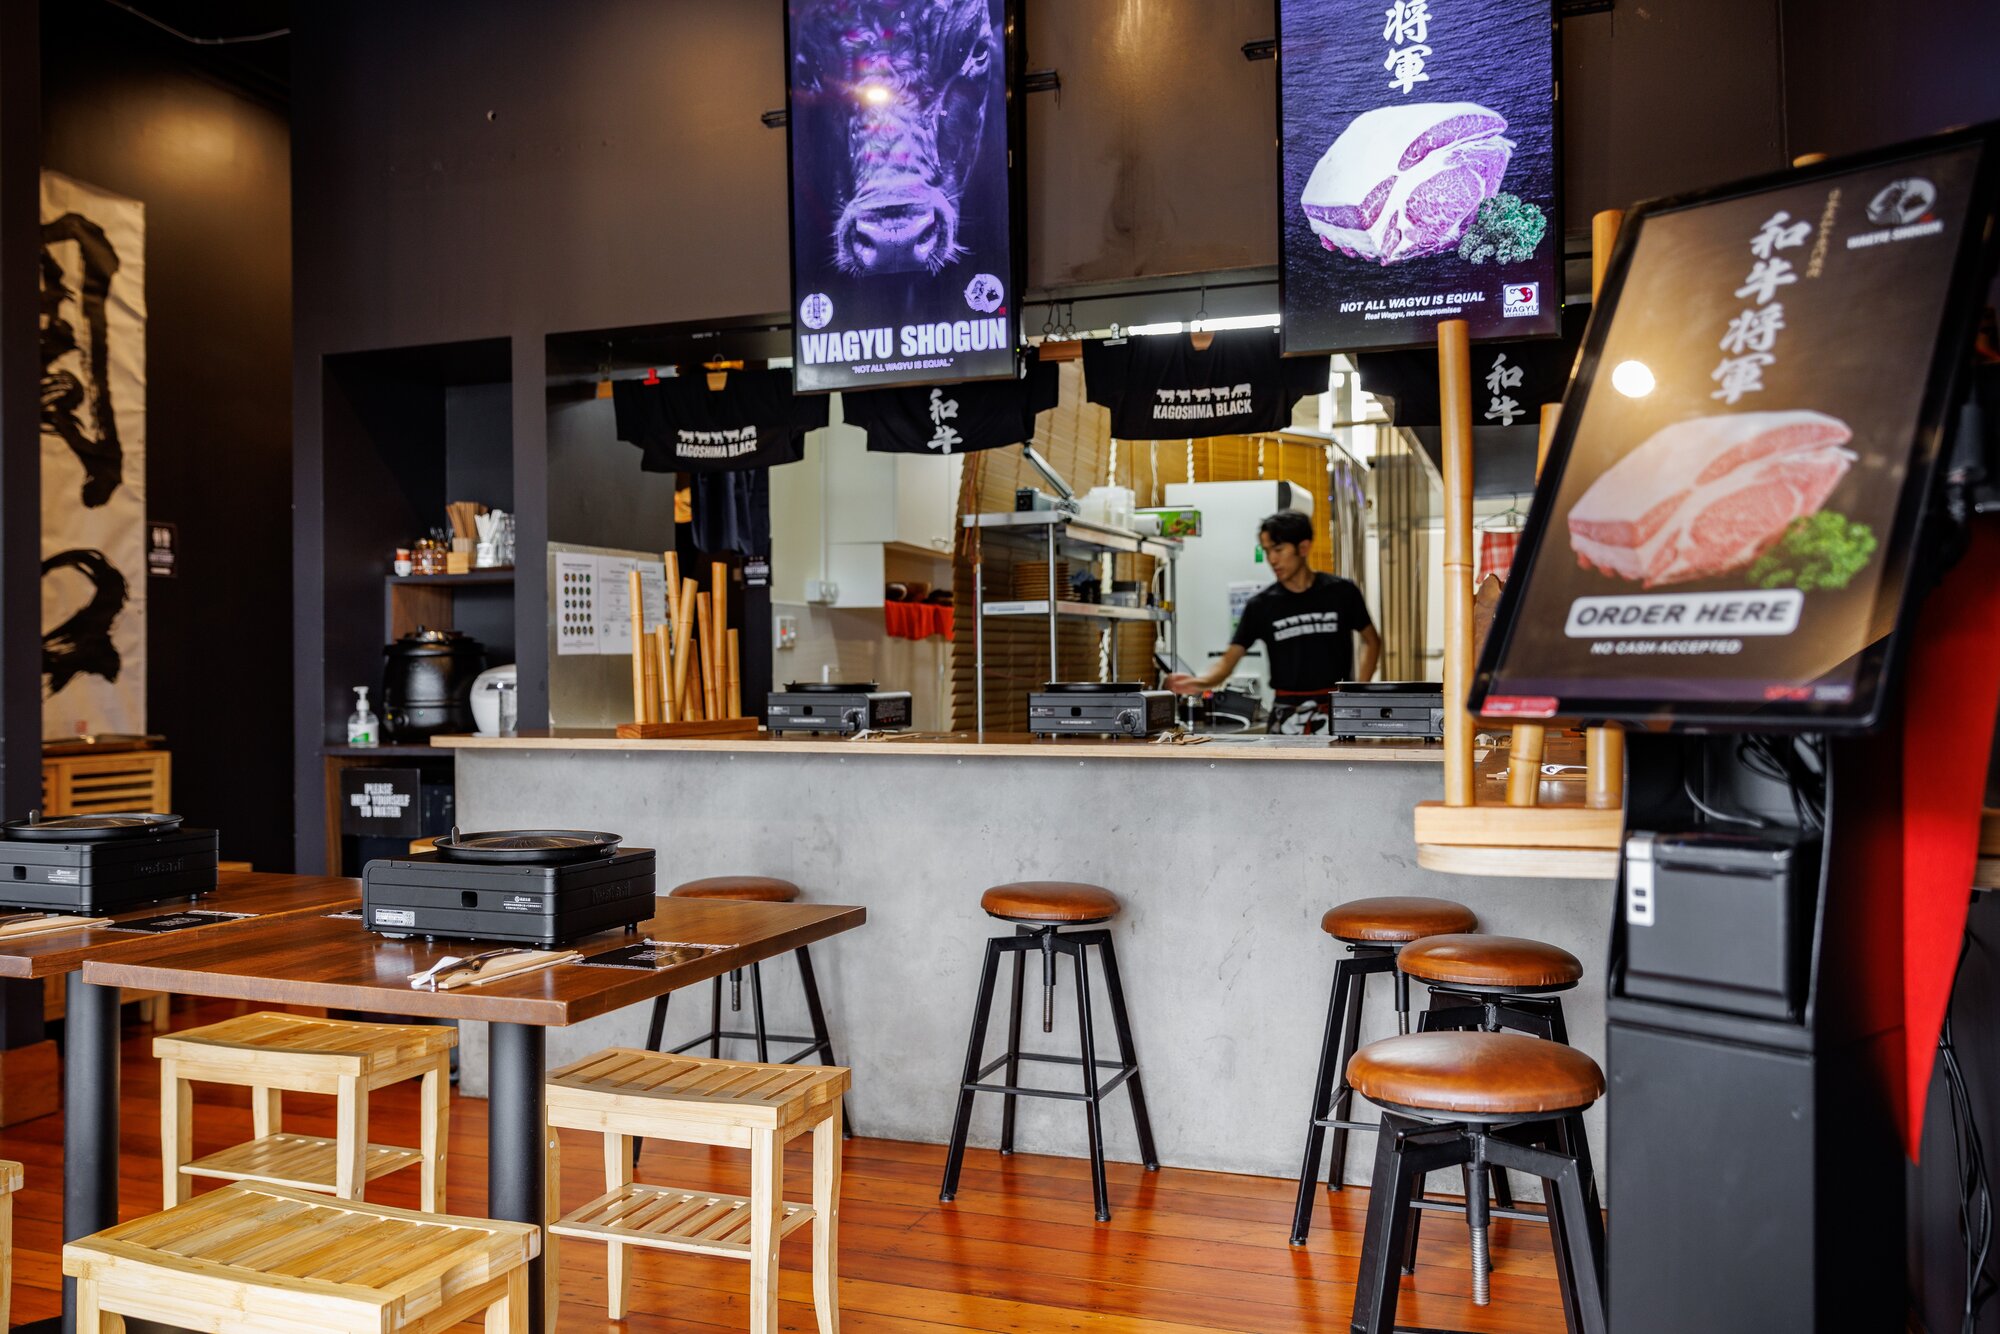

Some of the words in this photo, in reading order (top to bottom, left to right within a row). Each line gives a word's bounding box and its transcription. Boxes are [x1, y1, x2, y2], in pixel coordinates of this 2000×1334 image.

[1340, 301, 1364, 313] NOT
[1364, 299, 1387, 311] ALL
[1389, 295, 1430, 309] WAGYU
[1431, 294, 1444, 306] IS
[1446, 291, 1485, 305] EQUAL
[1504, 305, 1539, 313] WAGYU
[1364, 312, 1380, 321] Real
[1380, 310, 1405, 321] Wagyu,
[1406, 310, 1415, 318] no
[1415, 306, 1462, 317] compromises
[800, 327, 893, 365] WAGYU
[900, 317, 1007, 357] SHOGUN
[870, 364, 885, 373] ALL
[885, 361, 914, 371] WAGYU
[914, 360, 923, 370] IS
[1484, 352, 1527, 427] 和牛
[1152, 403, 1215, 420] KAGOSHIMA
[1215, 398, 1253, 417] BLACK
[927, 387, 964, 455] 和牛
[676, 442, 728, 458] KAGOSHIMA
[728, 439, 758, 458] BLACK
[1576, 603, 1687, 626] ORDER
[1694, 599, 1792, 624] HERE
[1590, 640, 1614, 655] NO
[1614, 640, 1658, 655] CASH
[1658, 638, 1744, 655] ACCEPTED
[364, 782, 394, 795] PLEASE
